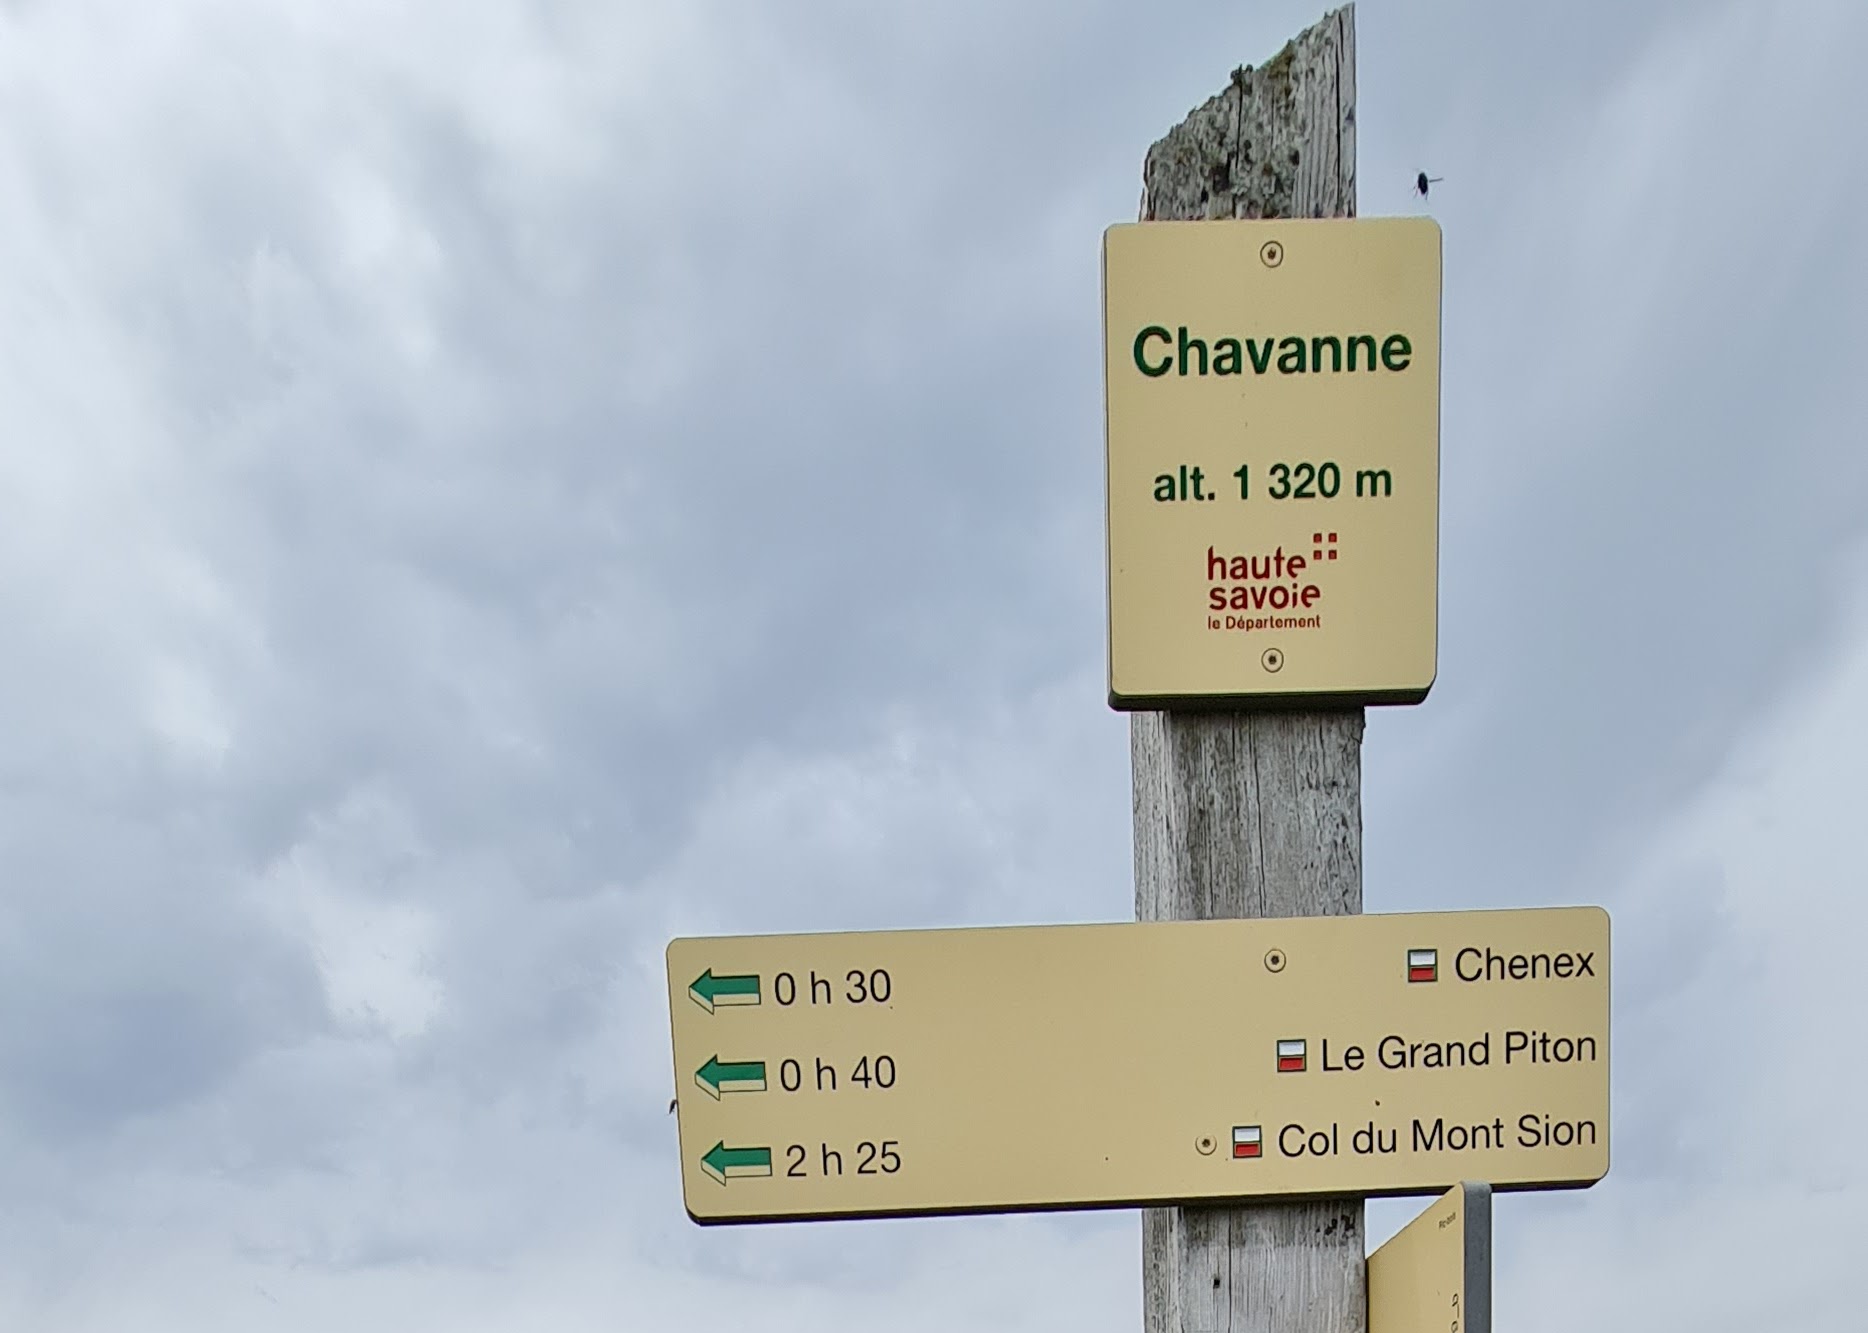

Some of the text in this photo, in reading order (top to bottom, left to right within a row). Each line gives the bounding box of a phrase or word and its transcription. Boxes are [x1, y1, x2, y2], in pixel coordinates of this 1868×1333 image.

[1134, 326, 1412, 378] Chavanne
[1154, 462, 1391, 502] alt. 1 320 m
[1208, 546, 1306, 580] haute
[1209, 583, 1320, 610] savoie
[1208, 615, 1320, 632] le Département
[1456, 947, 1595, 982] Chenex
[775, 969, 891, 1006] 0 h 30
[1323, 1031, 1596, 1071] Le Grand Piton
[781, 1055, 895, 1091] 0 h 40
[1279, 1114, 1595, 1157] Col du Mont Sion
[787, 1141, 901, 1177] 2 h 25
